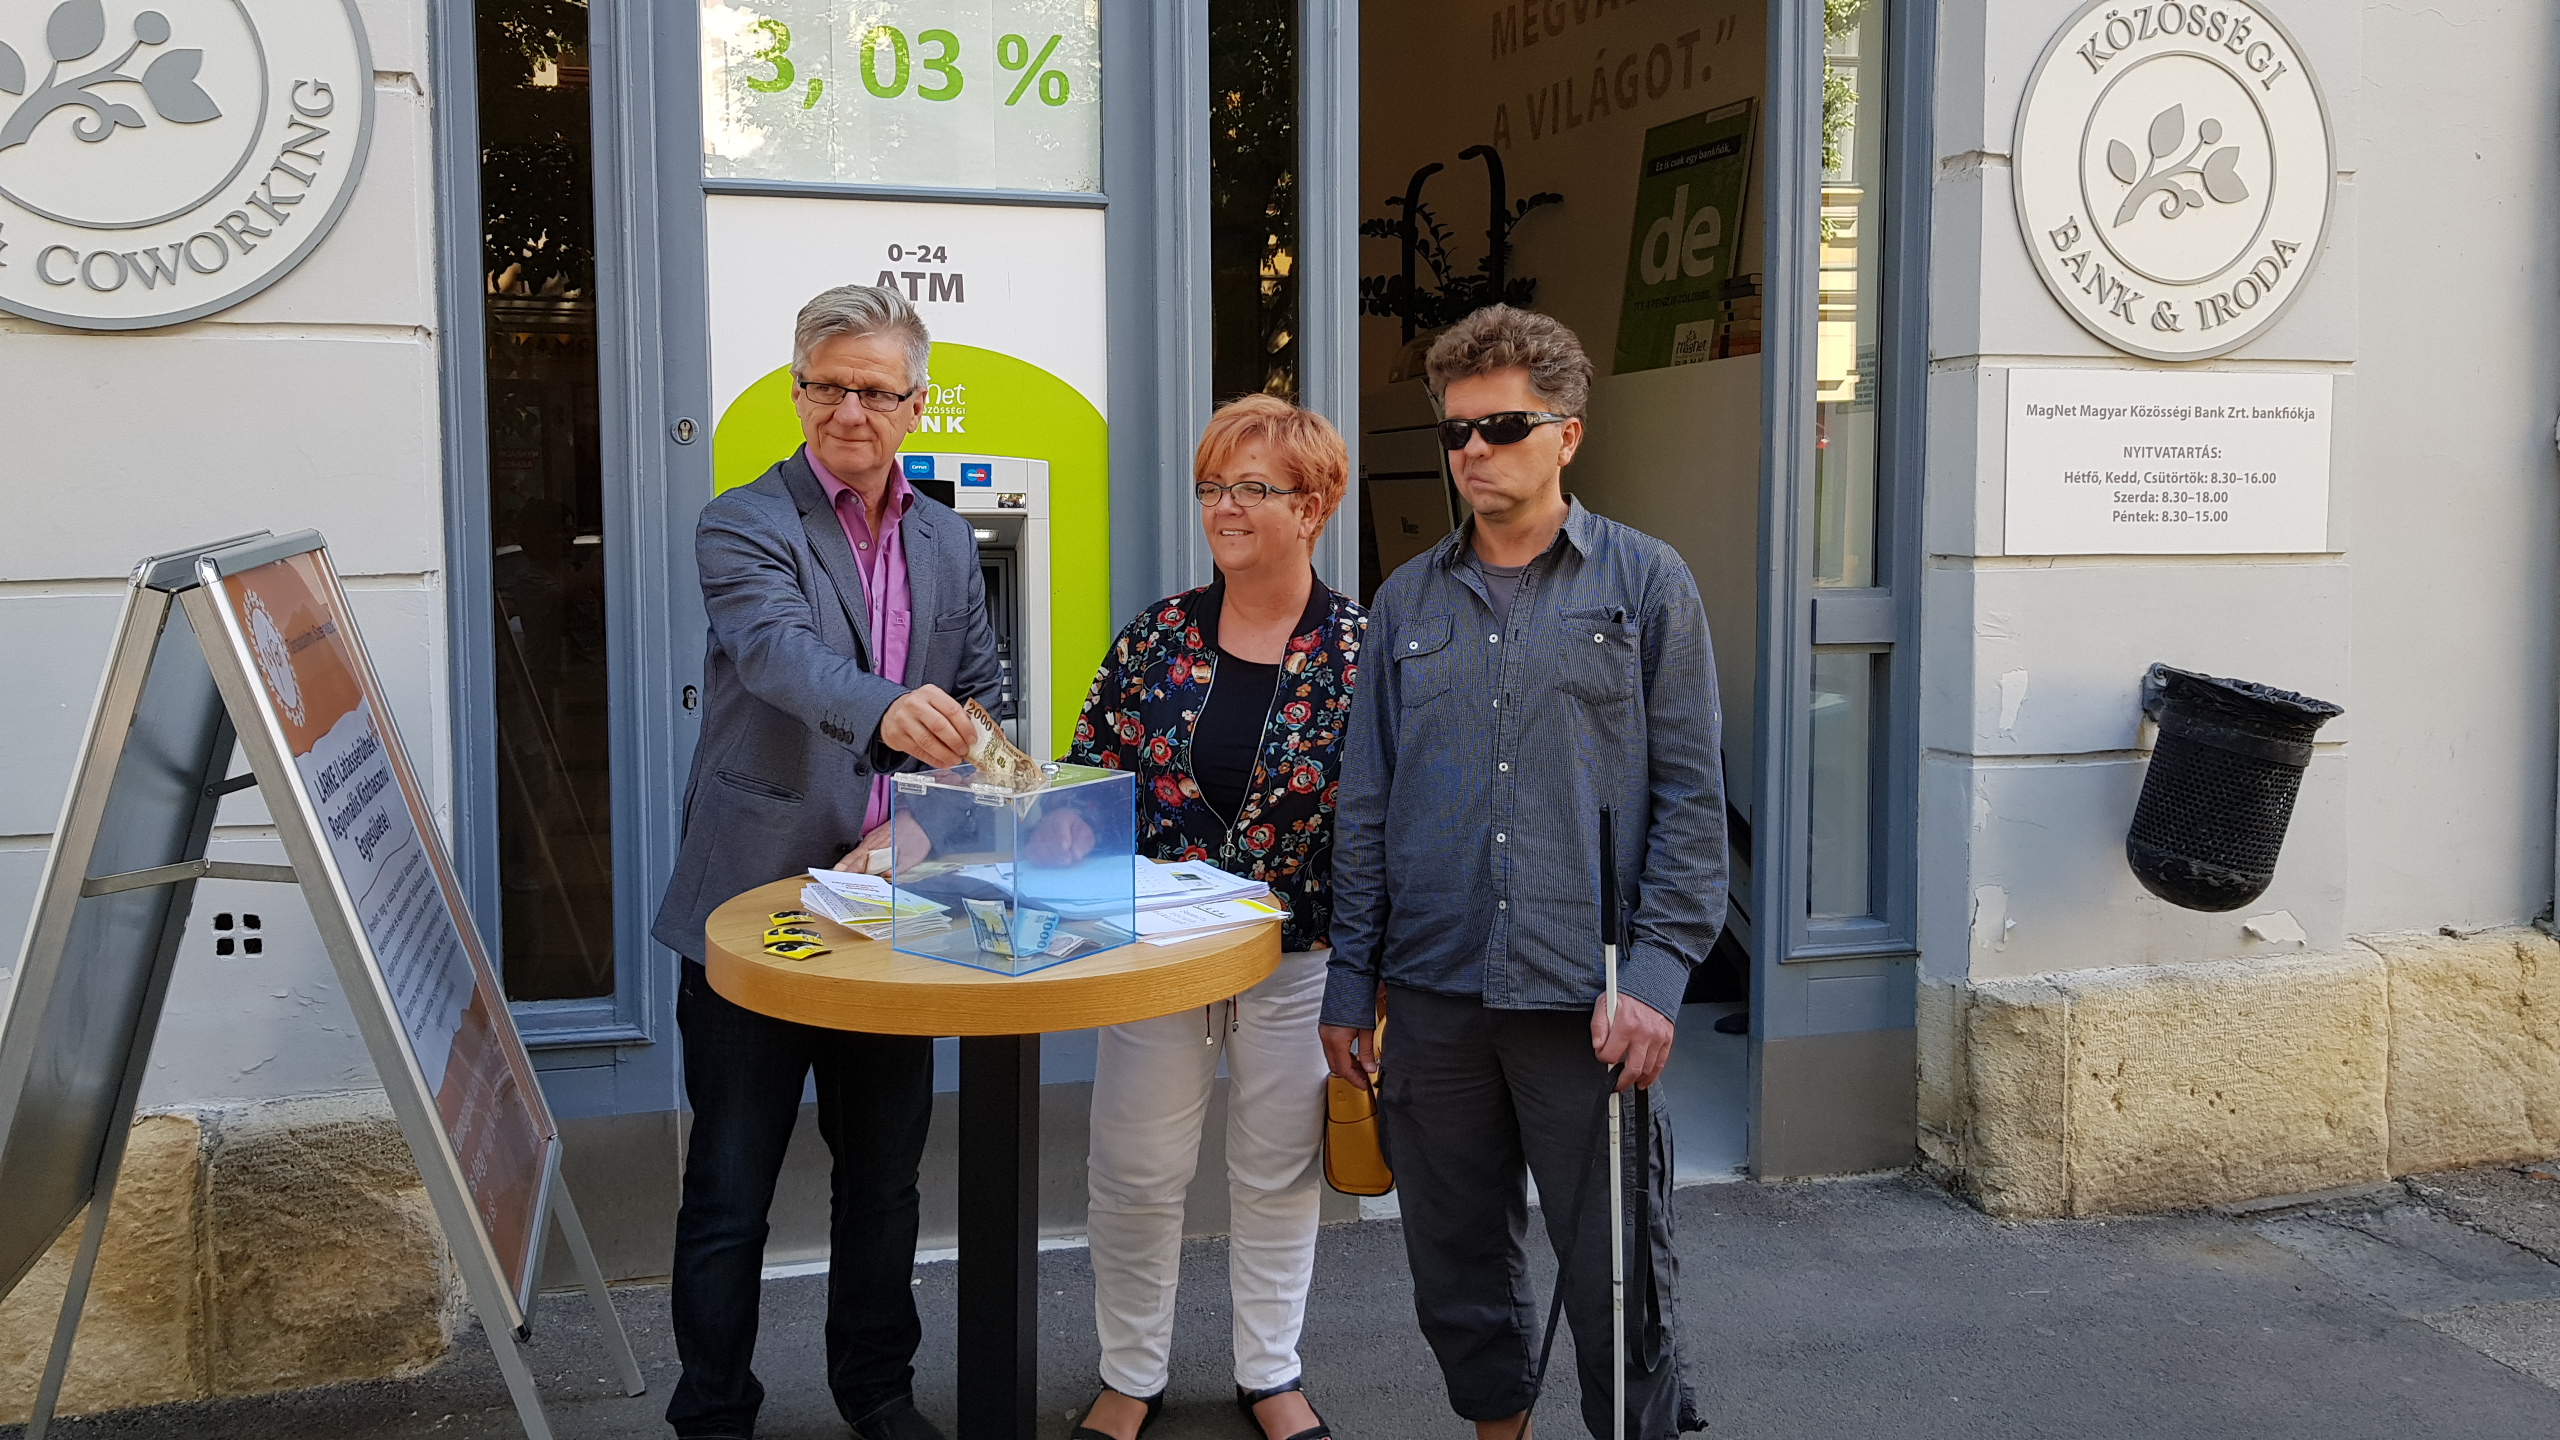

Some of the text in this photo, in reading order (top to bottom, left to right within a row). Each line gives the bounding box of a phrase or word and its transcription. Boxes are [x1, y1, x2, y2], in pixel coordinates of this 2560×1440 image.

[2076, 0, 2287, 92] KÖZÖSSÉGI
[859, 25, 964, 102] 03
[996, 34, 1070, 107] %
[1493, 102, 1512, 150] A
[37, 78, 334, 291] COWORKING
[1639, 183, 1722, 286] de
[876, 270, 964, 303] ATM
[2048, 214, 2301, 333] BANK & IRODA
[2026, 404, 2315, 422] MagNet Magyar Közösségi Bank Zrt. bankfiókja
[2123, 444, 2222, 459] NYITVATARTÁS:
[2064, 471, 2102, 485] Hétfő,
[2105, 471, 2141, 485] Kedd,
[2143, 471, 2208, 484] Csütörtök:
[2113, 490, 2159, 503] Szerda:
[2112, 510, 2159, 523] Péntek:
[966, 702, 993, 732] 2000
[314, 764, 341, 804] LÁRKE
[1036, 914, 1057, 949] 1000
